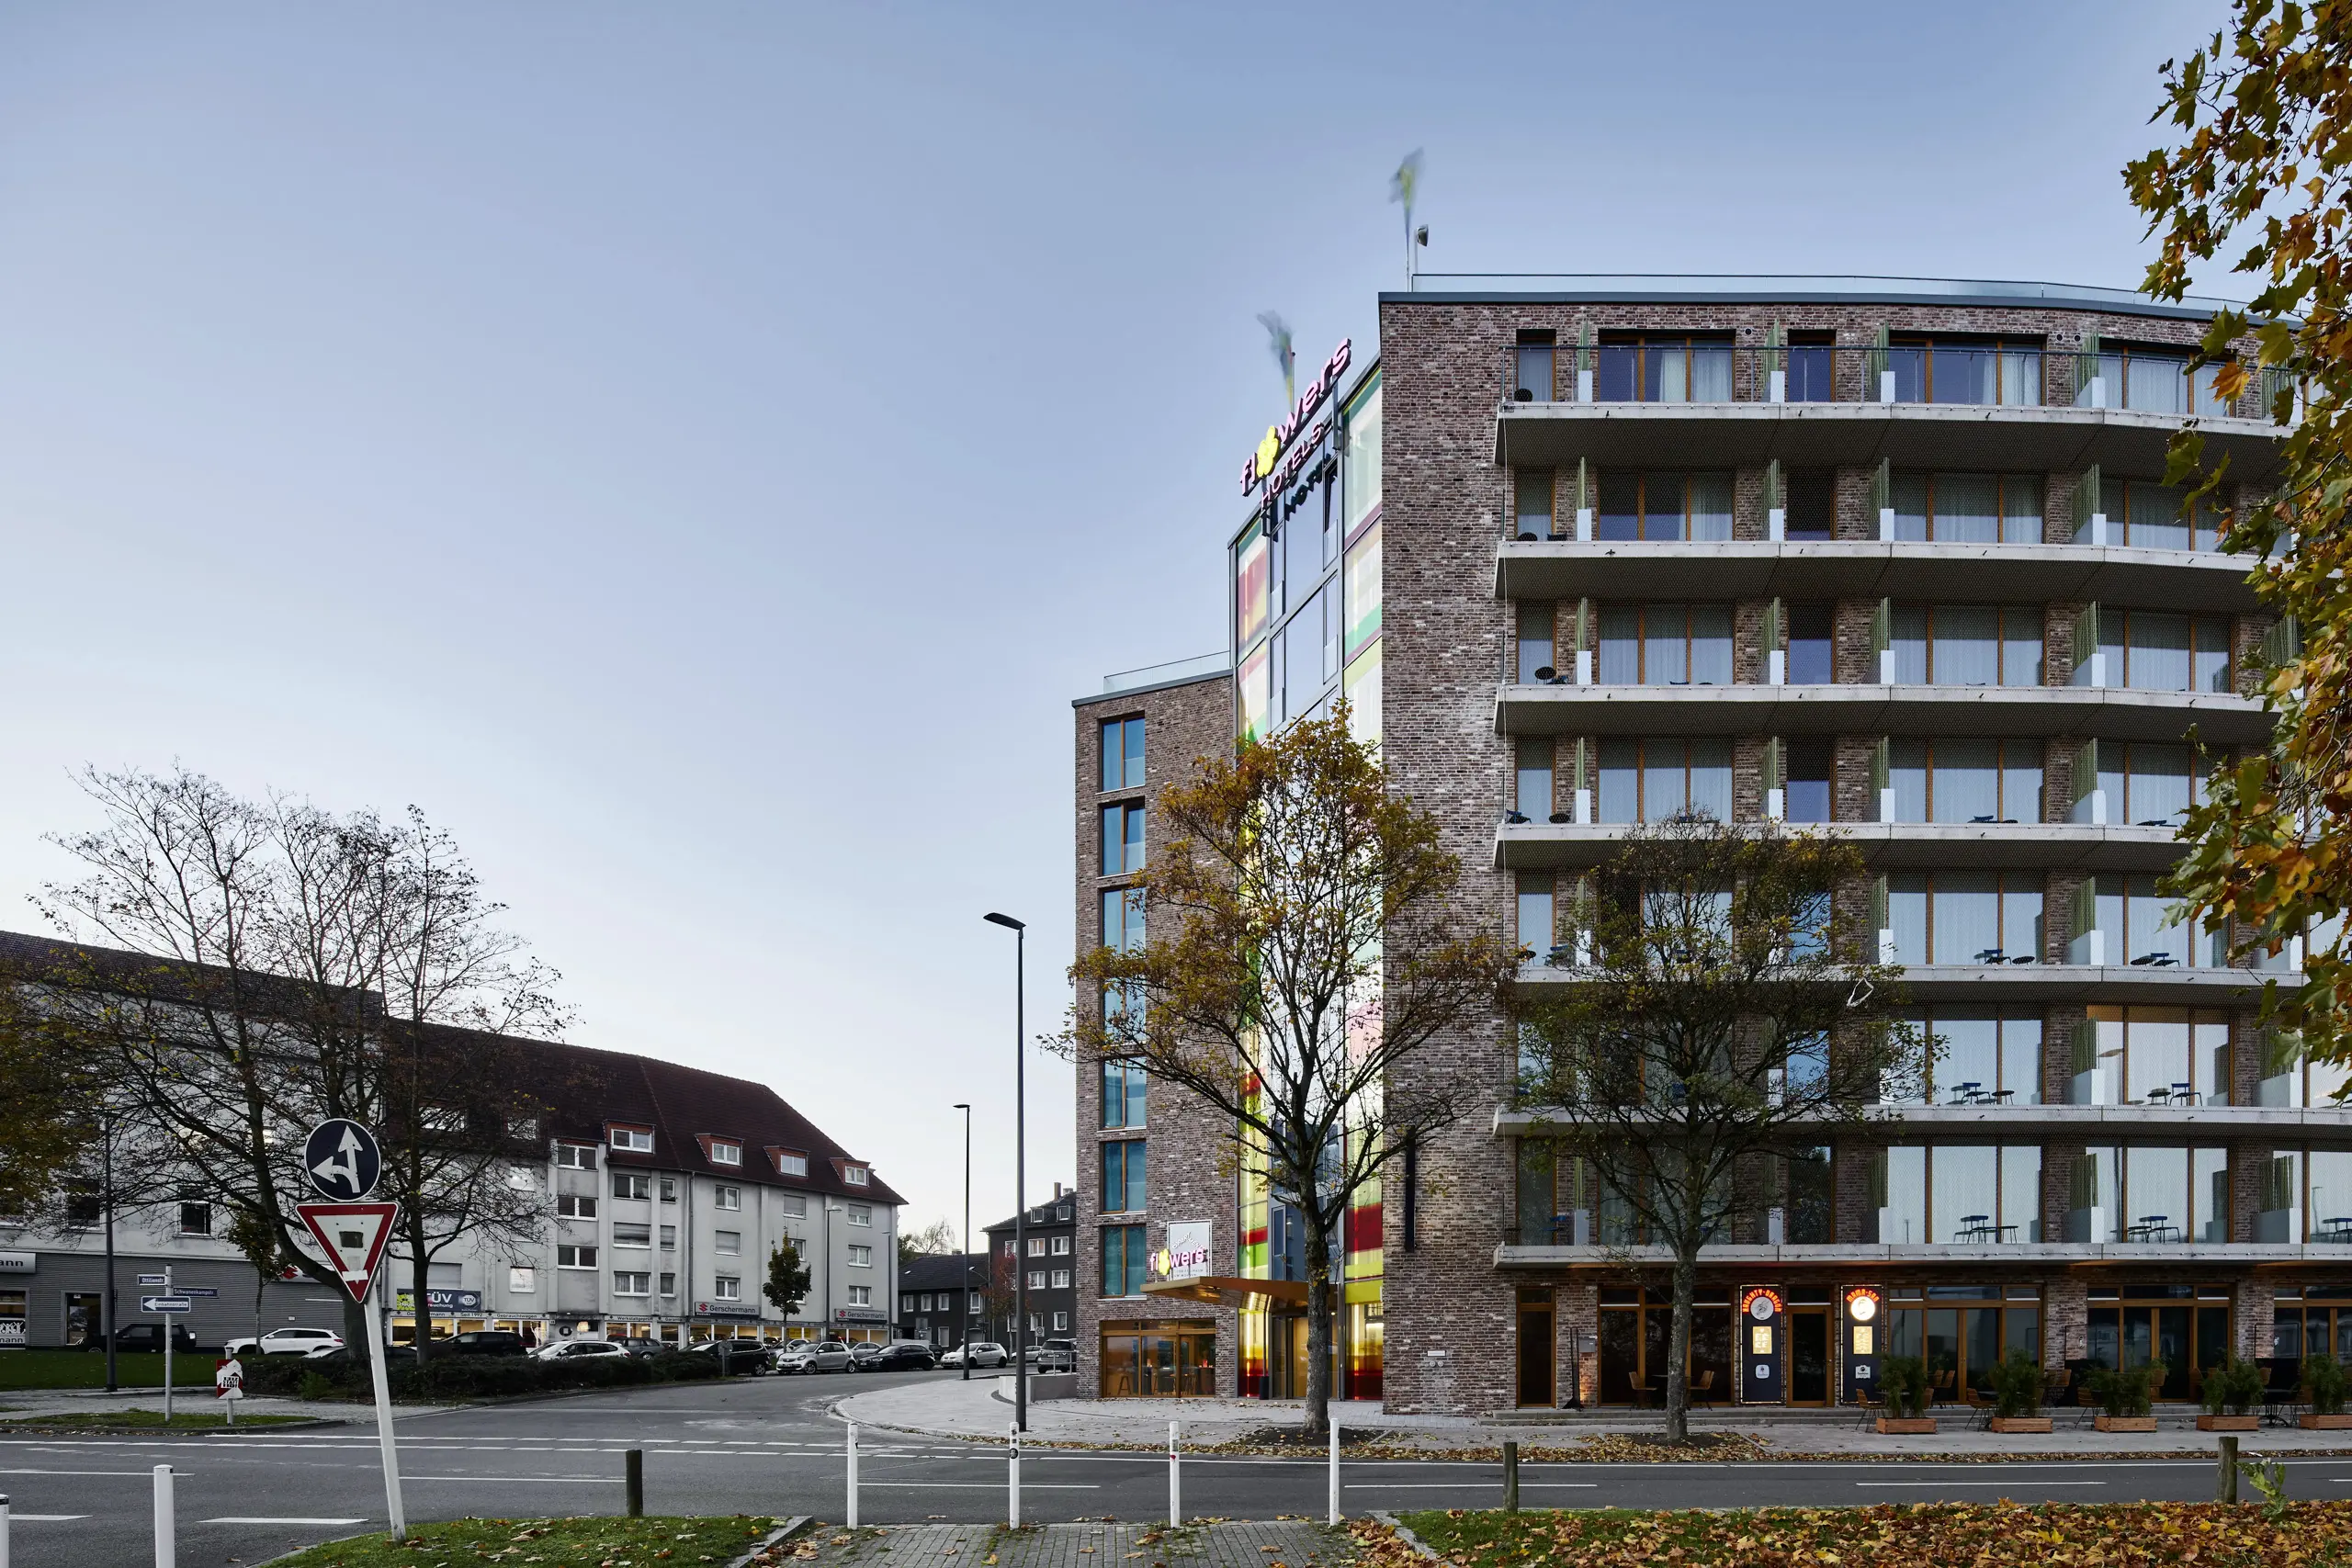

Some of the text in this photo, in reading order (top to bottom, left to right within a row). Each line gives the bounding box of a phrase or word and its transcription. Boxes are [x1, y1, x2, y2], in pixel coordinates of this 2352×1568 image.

[1261, 421, 1325, 512] HOTELS
[426, 1292, 453, 1303] ÜV
[709, 1305, 756, 1314] Gerschermann
[847, 1311, 885, 1319] Gerschermann
